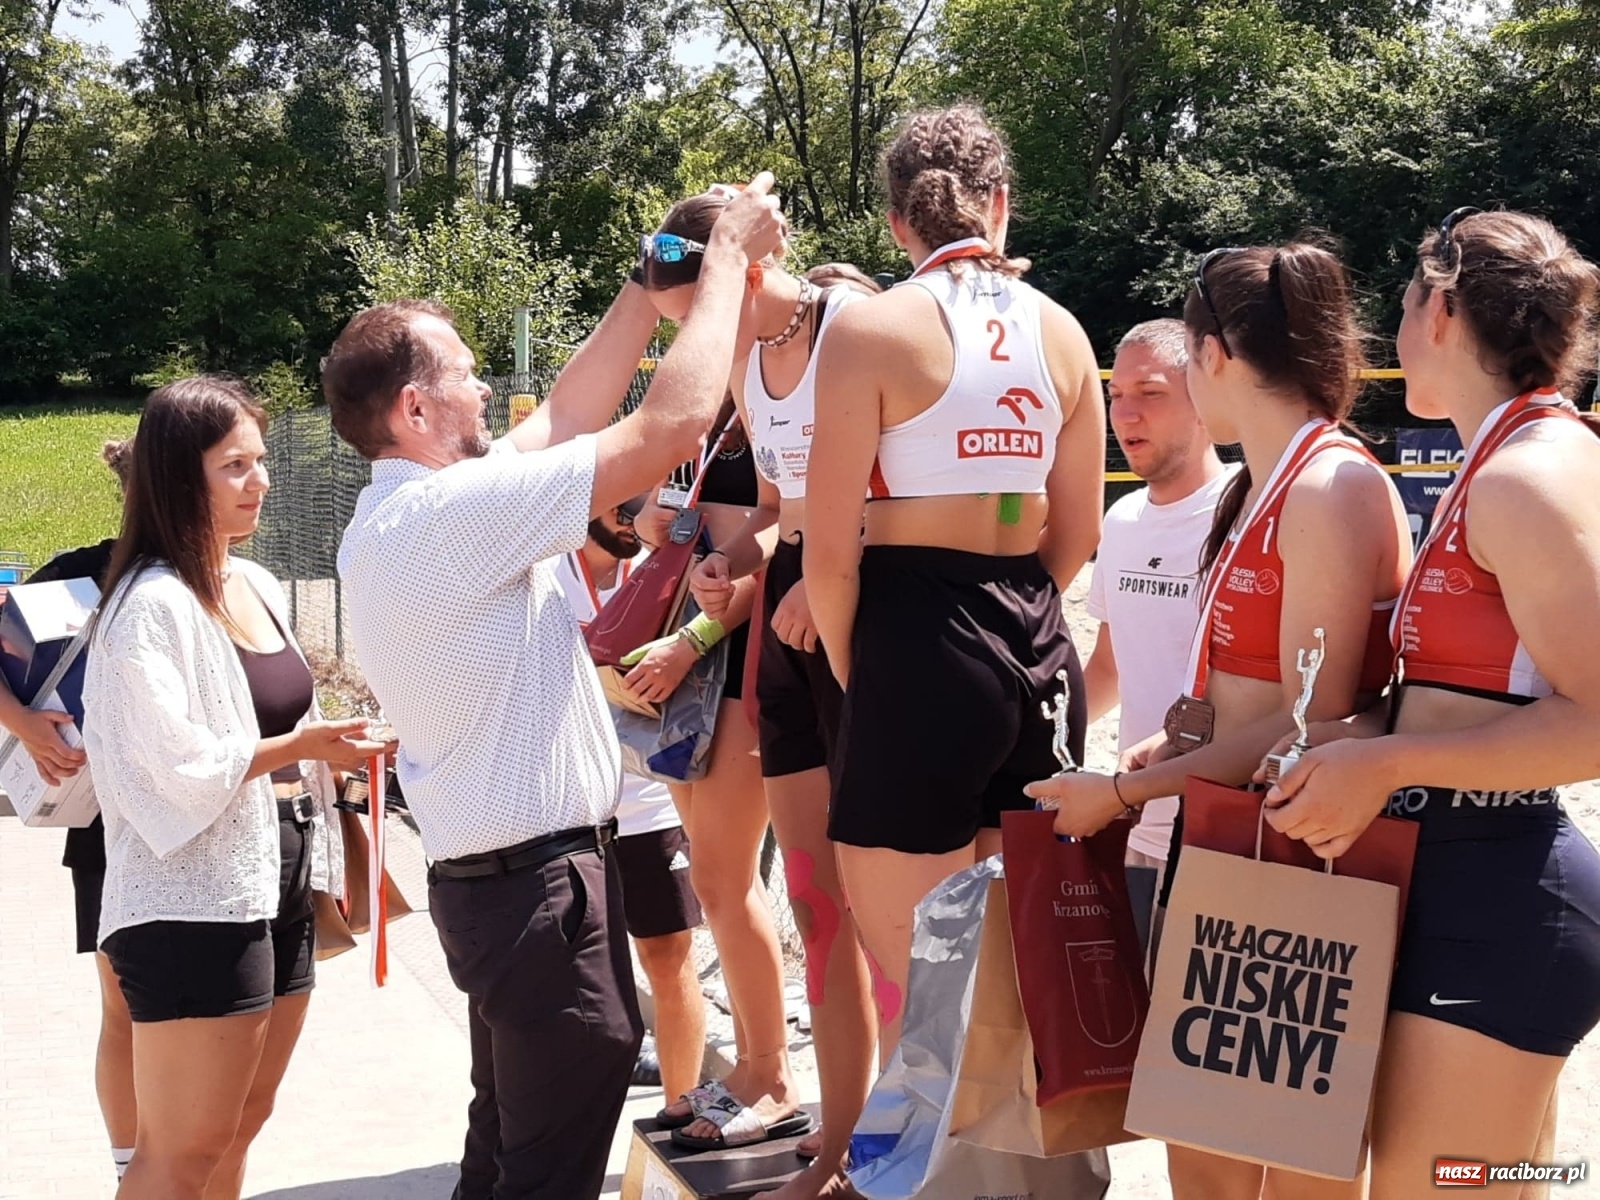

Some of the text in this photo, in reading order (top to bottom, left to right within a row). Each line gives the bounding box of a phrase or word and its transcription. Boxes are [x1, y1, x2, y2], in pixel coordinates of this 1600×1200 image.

[986, 319, 1010, 362] 2
[962, 432, 1039, 455] ORLEN
[1262, 516, 1275, 554] 1
[1118, 576, 1189, 598] SPORTSWEAR
[1195, 914, 1358, 975] WŁĄCZAMY
[1183, 947, 1353, 1033] NISKIE
[1171, 1005, 1338, 1095] CENY!
